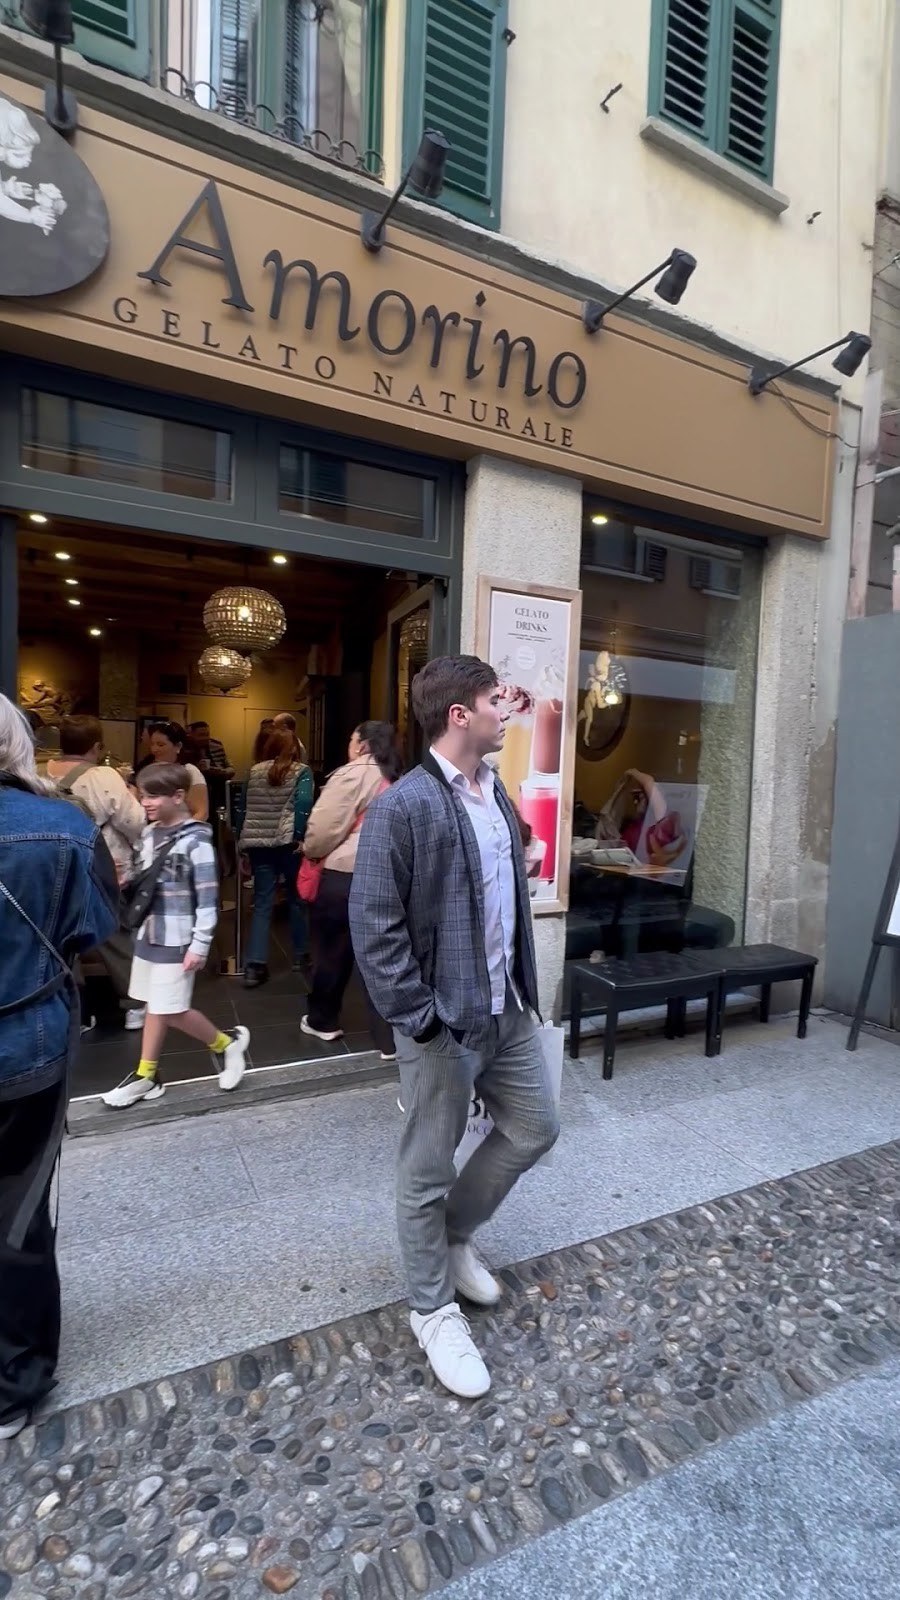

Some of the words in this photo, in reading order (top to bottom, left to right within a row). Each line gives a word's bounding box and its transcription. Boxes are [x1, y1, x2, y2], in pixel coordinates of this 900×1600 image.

[137, 178, 588, 409] Amorino
[113, 296, 337, 380] GELATO
[373, 371, 575, 448] NATURALE
[514, 607, 550, 620] GELATO
[515, 620, 548, 633] DRINKS
